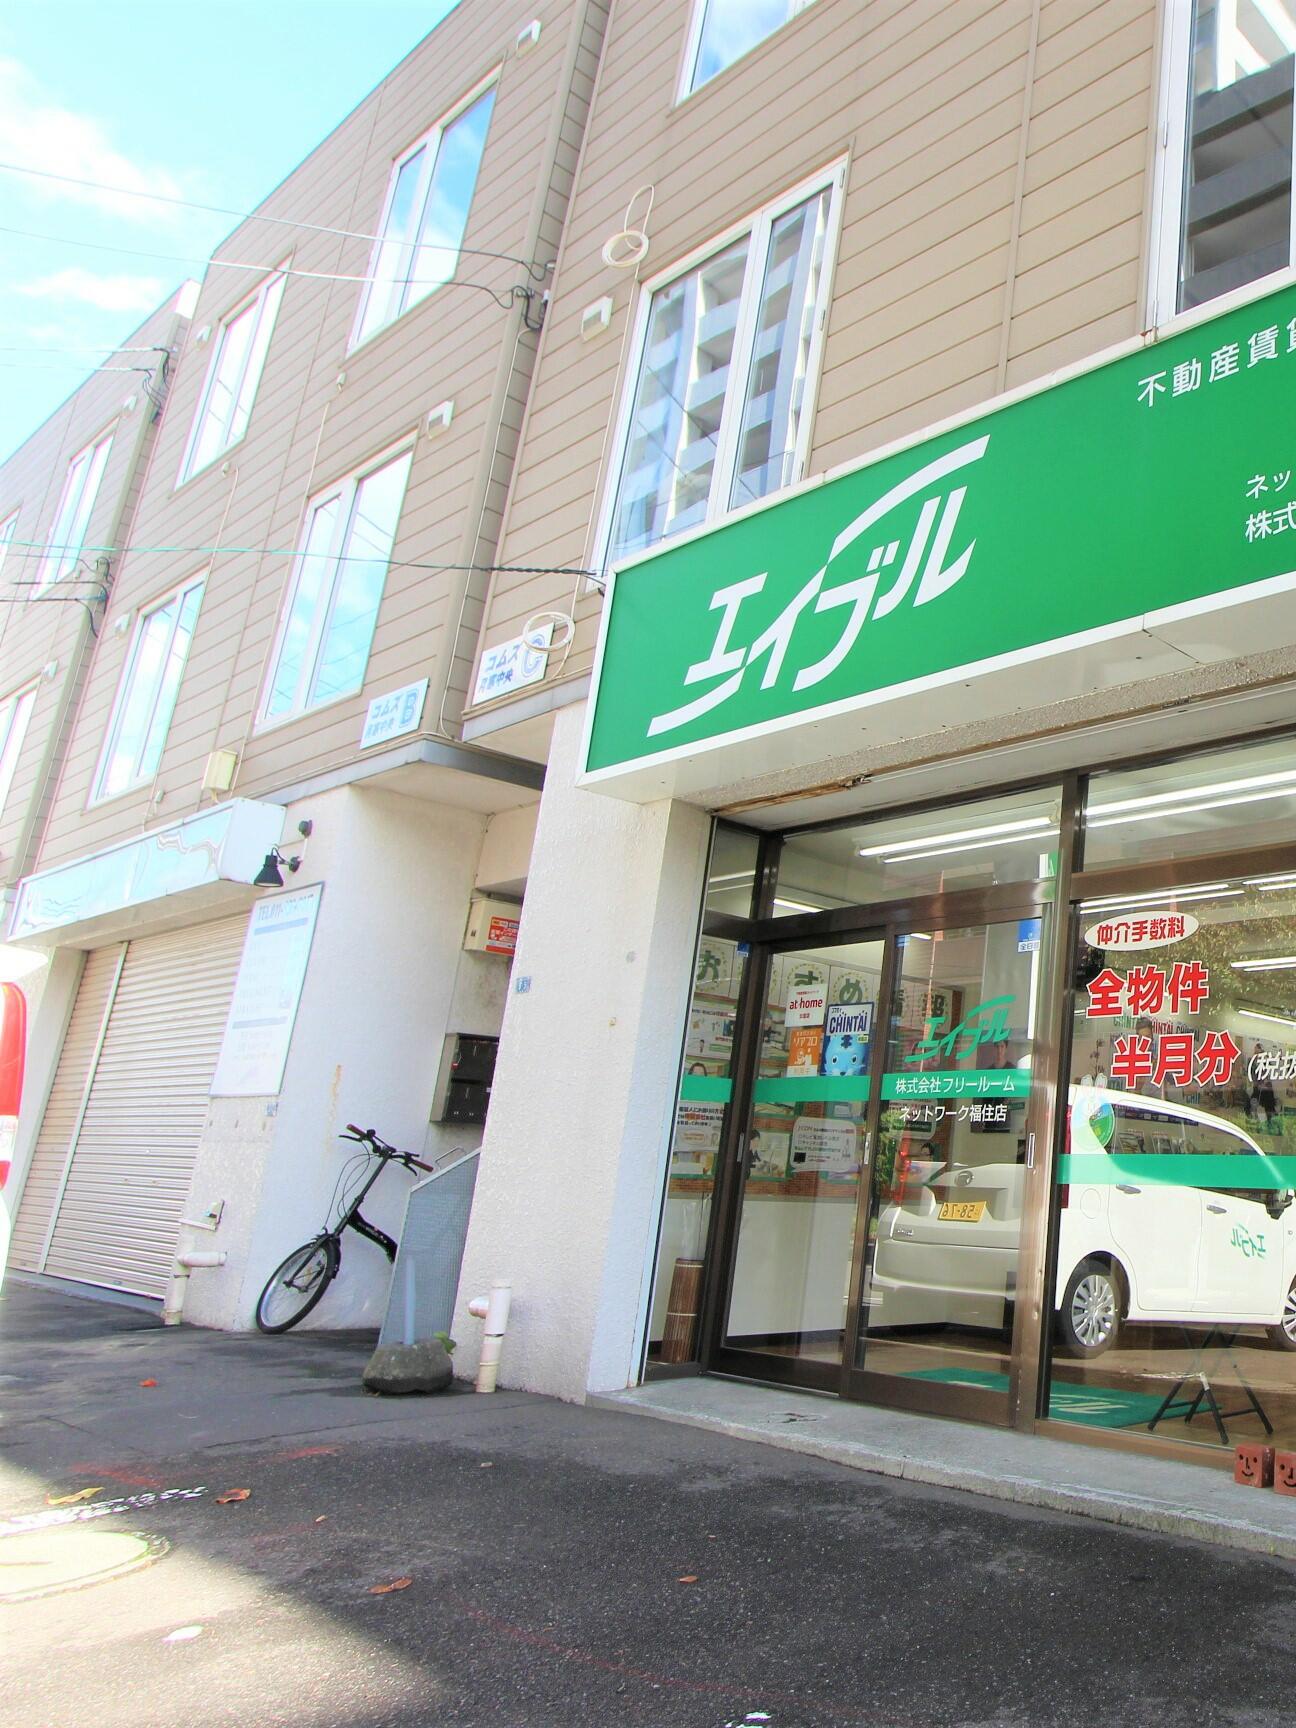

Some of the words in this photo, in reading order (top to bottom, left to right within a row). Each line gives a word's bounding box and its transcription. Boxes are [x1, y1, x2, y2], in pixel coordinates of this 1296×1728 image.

[646, 434, 991, 738] エイブル
[1097, 915, 1185, 945] 仲介手数料
[790, 999, 798, 1009] at
[800, 997, 823, 1009] home
[1086, 961, 1209, 1018] 全物件
[904, 995, 1016, 1062] エイブル
[1111, 1030, 1241, 1089] 半月分
[895, 1075, 1015, 1094] 株式会社フリールーム
[899, 1103, 1008, 1122] ネットワーク福住店
